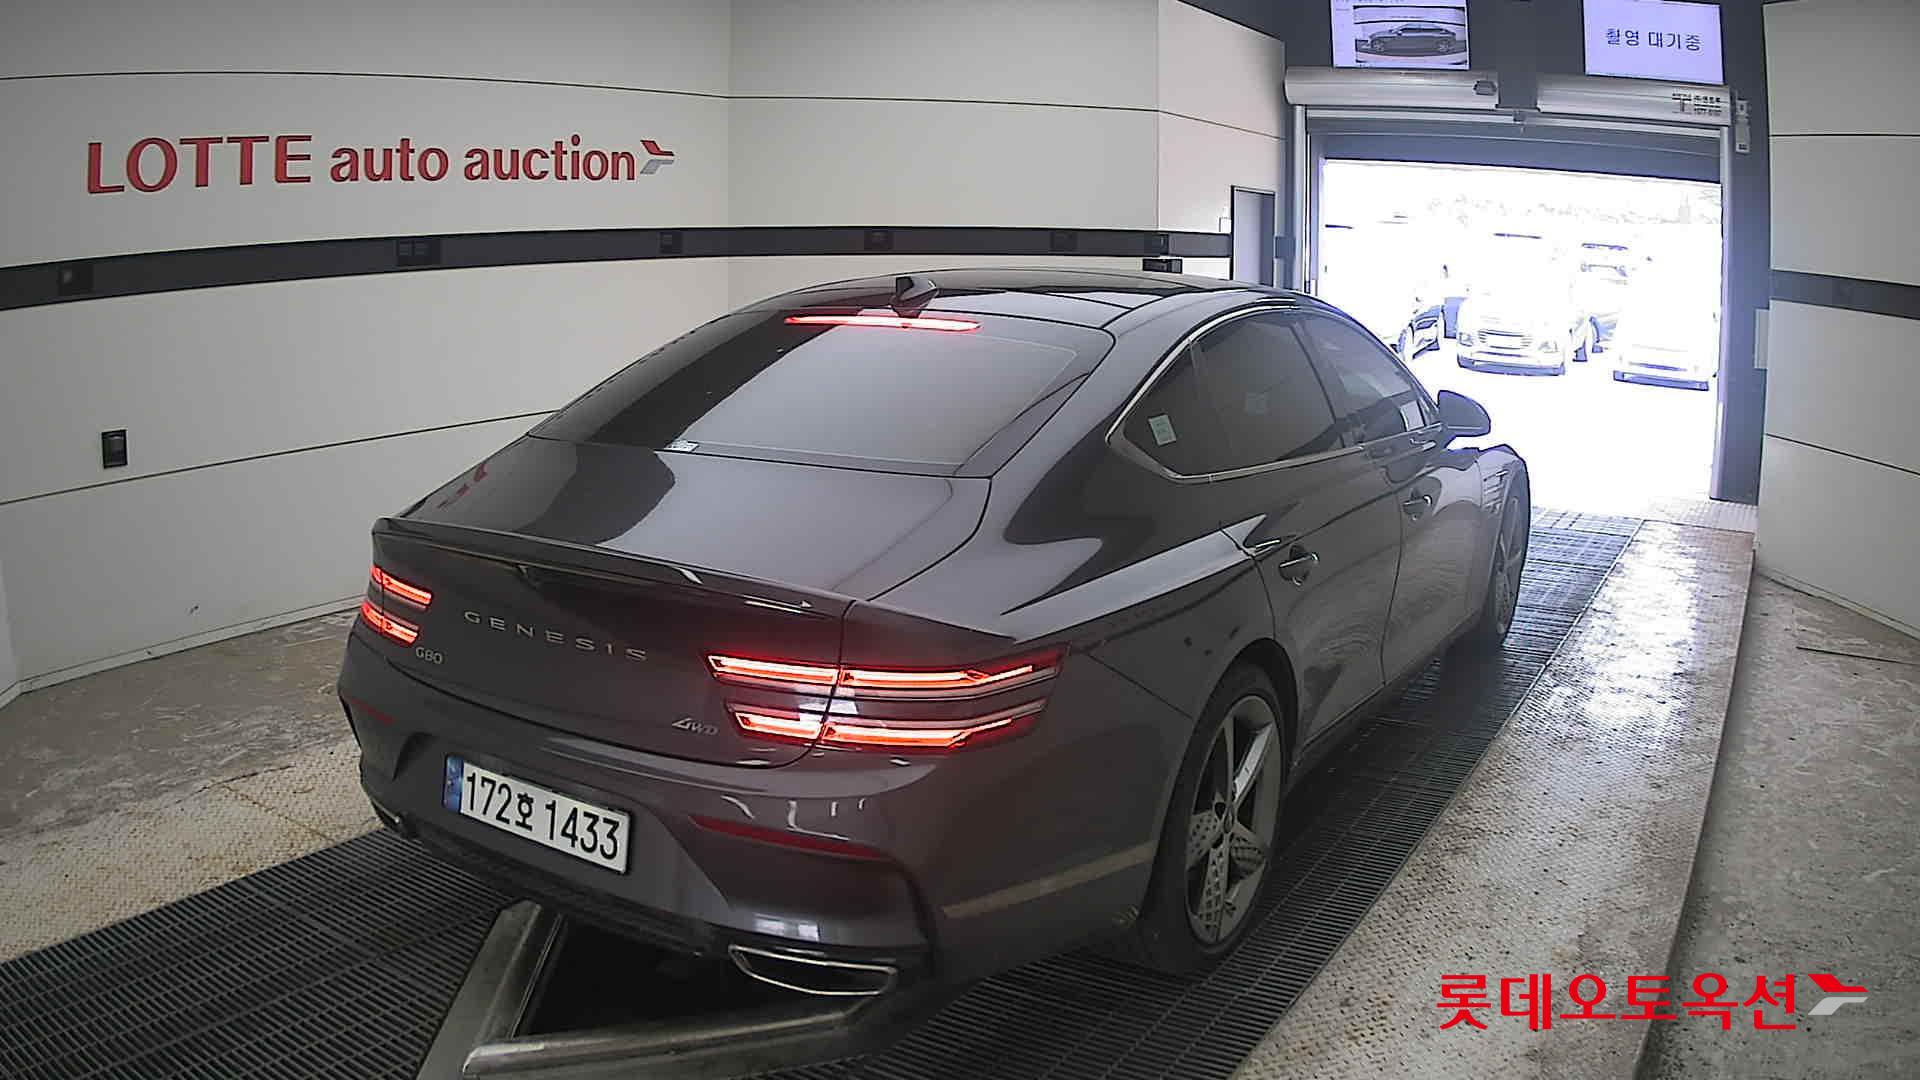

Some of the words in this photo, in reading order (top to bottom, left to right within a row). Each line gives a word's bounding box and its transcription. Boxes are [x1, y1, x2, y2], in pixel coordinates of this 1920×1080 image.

[1648, 31, 1701, 52] 대기중
[87, 135, 313, 194] LOTTE
[330, 138, 450, 183] auto
[463, 134, 636, 182] auction
[463, 610, 648, 662] GENESIS
[415, 646, 444, 665] G80
[671, 717, 719, 736] 4WD
[466, 771, 535, 832] 172호
[545, 799, 621, 861] 1433
